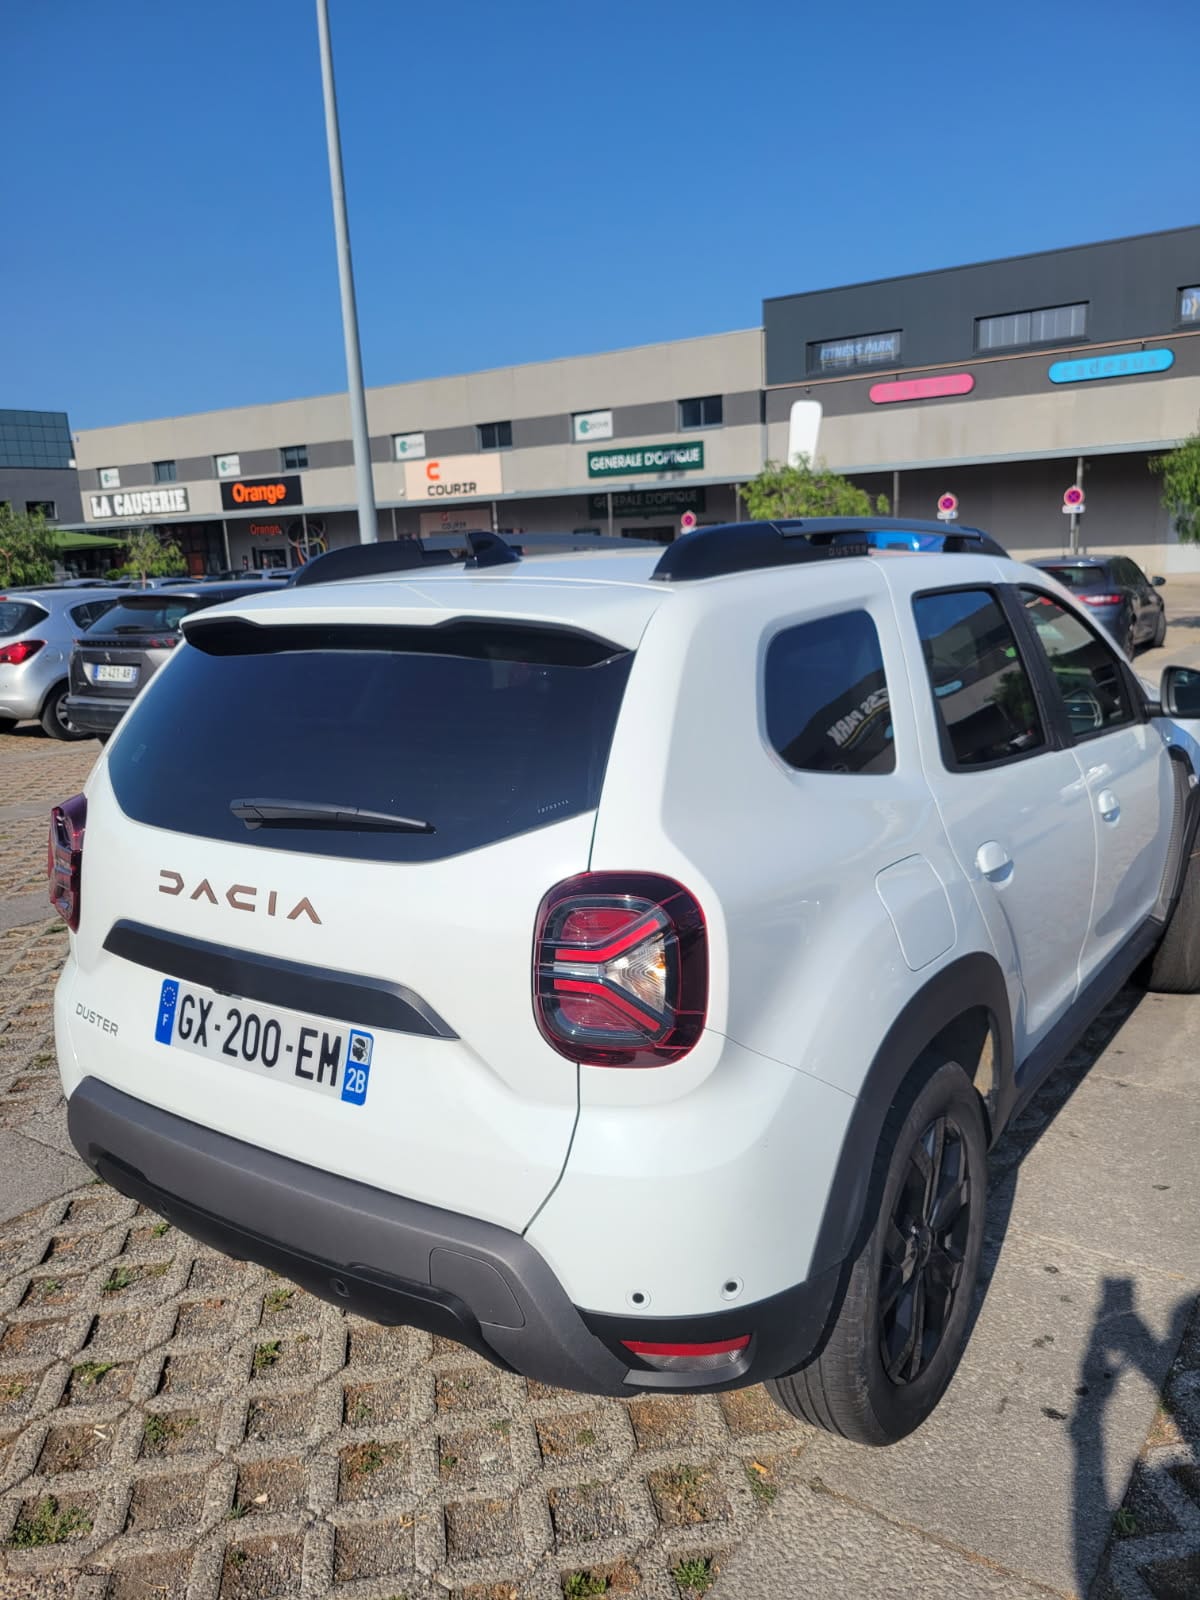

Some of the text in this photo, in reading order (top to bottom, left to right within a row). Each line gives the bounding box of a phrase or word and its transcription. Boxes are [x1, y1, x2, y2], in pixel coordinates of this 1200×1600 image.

[590, 448, 700, 470] GENERALE D'OPTIQUE
[232, 482, 286, 504] Orange
[427, 482, 477, 496] COURIR
[91, 488, 187, 517] LA CAUSERIE
[250, 523, 281, 535] Orange
[158, 869, 322, 925] DACIA
[75, 1002, 119, 1036] DUSTER
[162, 1013, 169, 1026] F
[178, 994, 342, 1087] GX-200-EM
[345, 1067, 367, 1094] 2B
